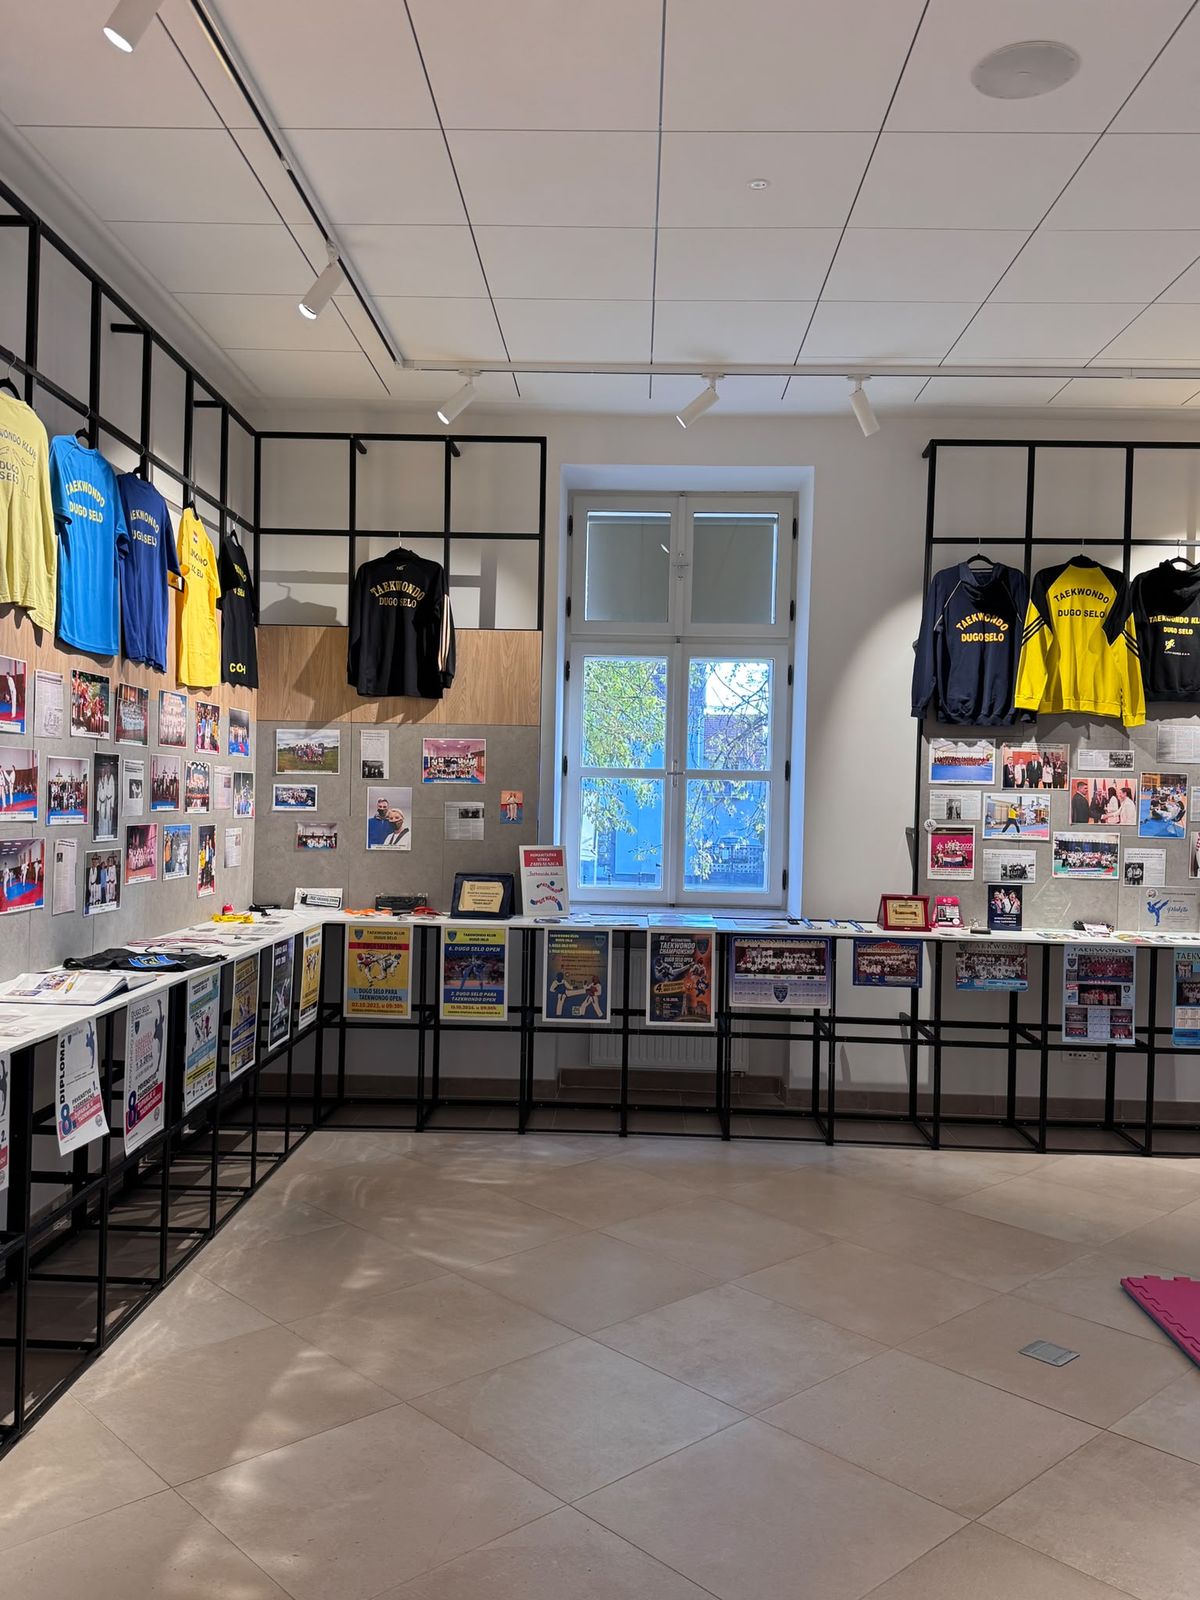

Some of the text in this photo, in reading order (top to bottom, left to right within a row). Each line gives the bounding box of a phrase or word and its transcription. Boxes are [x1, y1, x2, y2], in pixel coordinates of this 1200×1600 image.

[66, 480, 105, 508] TAEKWONDO
[69, 502, 104, 524] DUGO SELO
[370, 580, 426, 601] TAEKWONDO
[1053, 587, 1110, 604] TAEKWONDO
[379, 596, 416, 608] DUGO SELO
[956, 612, 1008, 632] TAEKWONDO
[1058, 608, 1106, 619] DUGO SELO
[1148, 614, 1189, 624] TAEKWONDO
[961, 632, 1004, 642] DUGO SELO
[72, 1088, 92, 1105] PRVENSTVO
[60, 1103, 77, 1136] 8.
